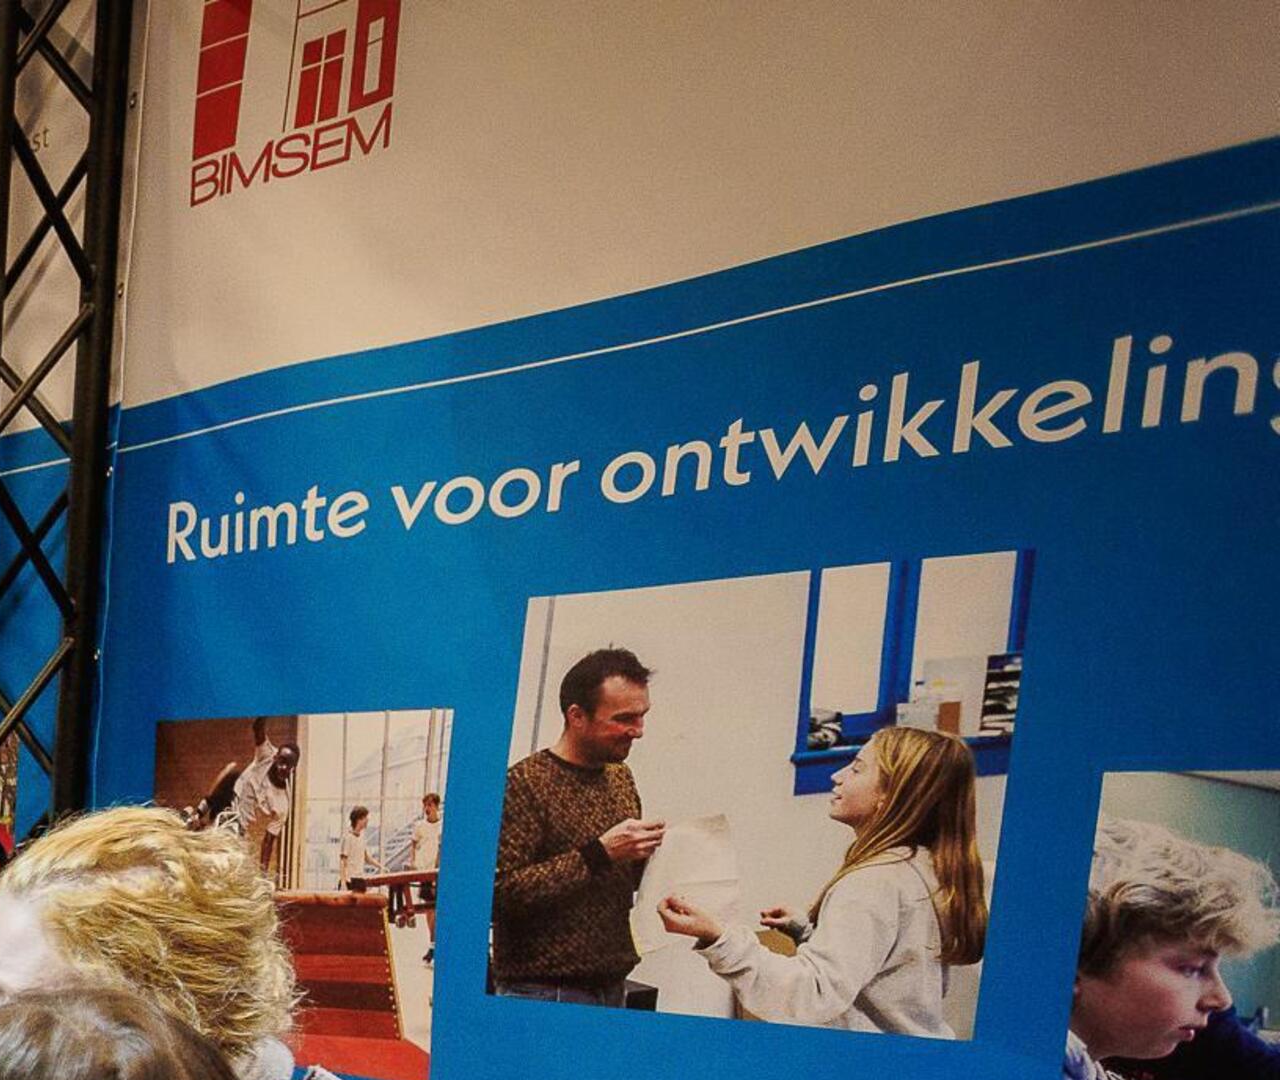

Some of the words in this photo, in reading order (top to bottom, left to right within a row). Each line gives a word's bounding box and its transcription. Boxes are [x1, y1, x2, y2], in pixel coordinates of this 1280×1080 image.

[190, 103, 391, 208] BIMSEM
[166, 488, 370, 564] Ruimte
[390, 457, 580, 531] voor
[600, 334, 1280, 505] ontwikkelin
